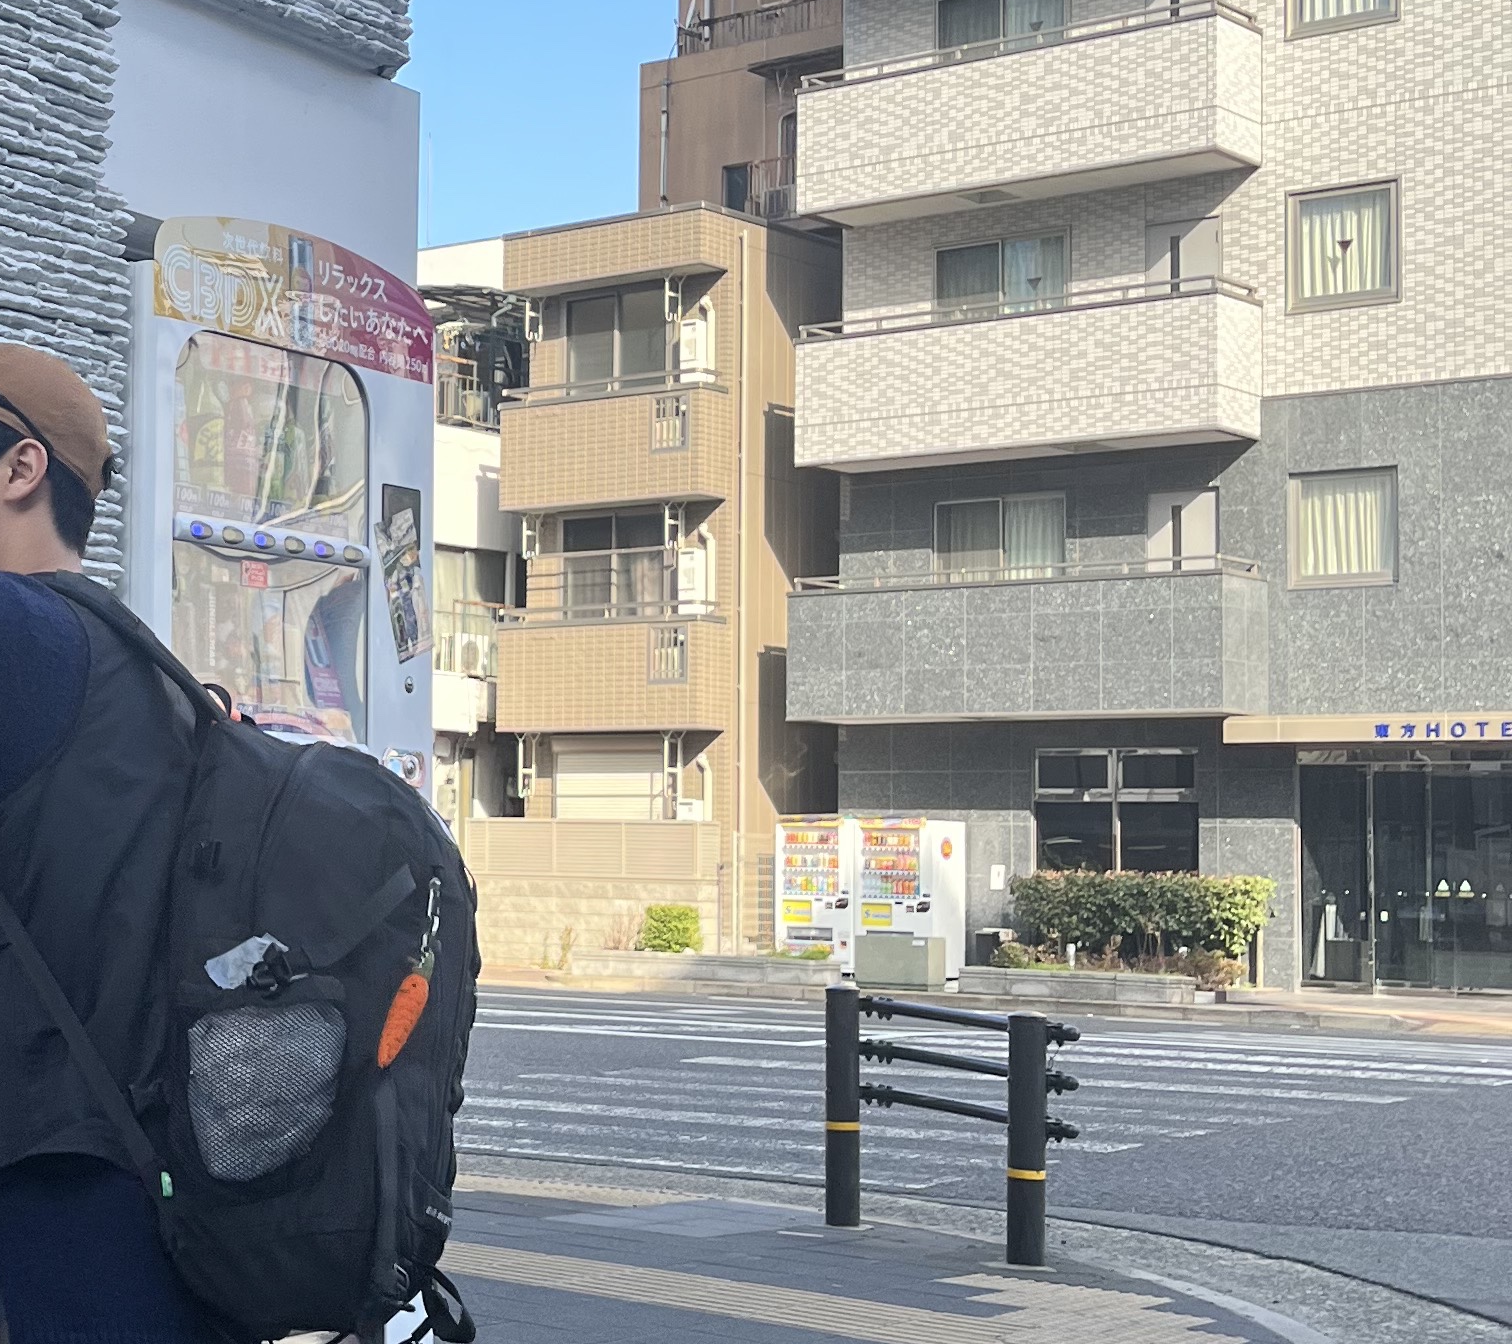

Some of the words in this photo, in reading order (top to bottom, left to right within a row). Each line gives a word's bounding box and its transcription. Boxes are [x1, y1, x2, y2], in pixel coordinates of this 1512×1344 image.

[318, 260, 389, 302] リラックス
[317, 298, 429, 346] したいあなたへ
